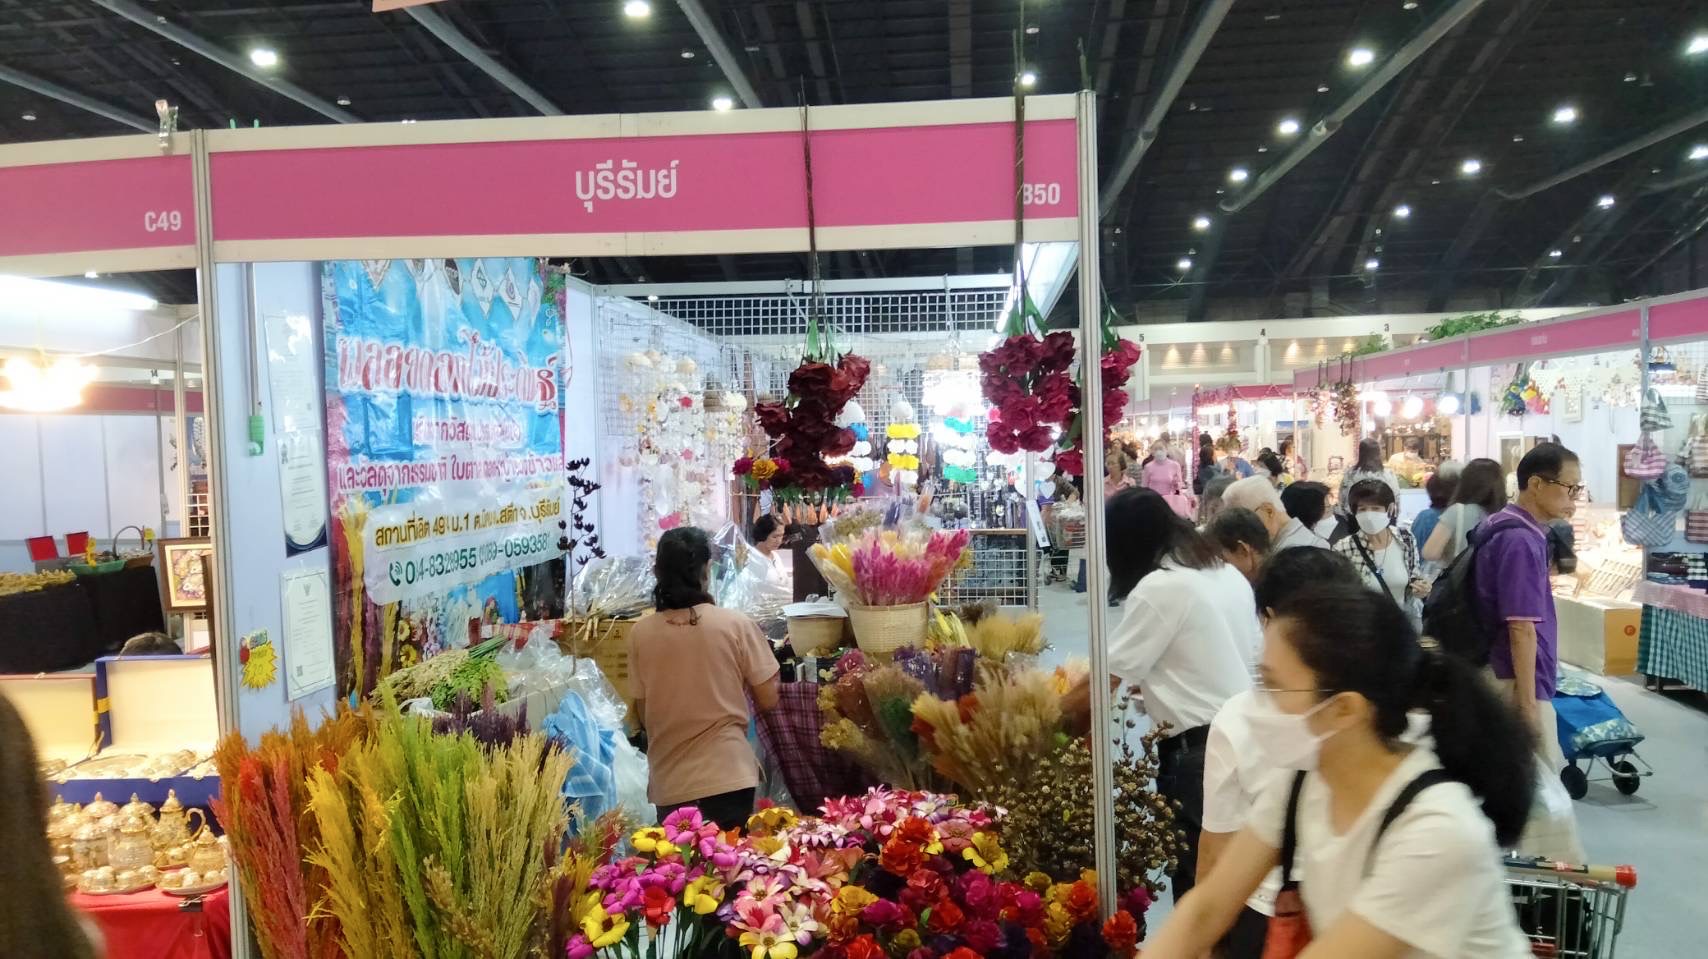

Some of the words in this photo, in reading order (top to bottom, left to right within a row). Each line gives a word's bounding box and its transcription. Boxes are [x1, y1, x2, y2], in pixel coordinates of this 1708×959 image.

[575, 159, 680, 213] บุรีรัมย์
[1023, 182, 1061, 206] B50
[144, 210, 182, 232] C49
